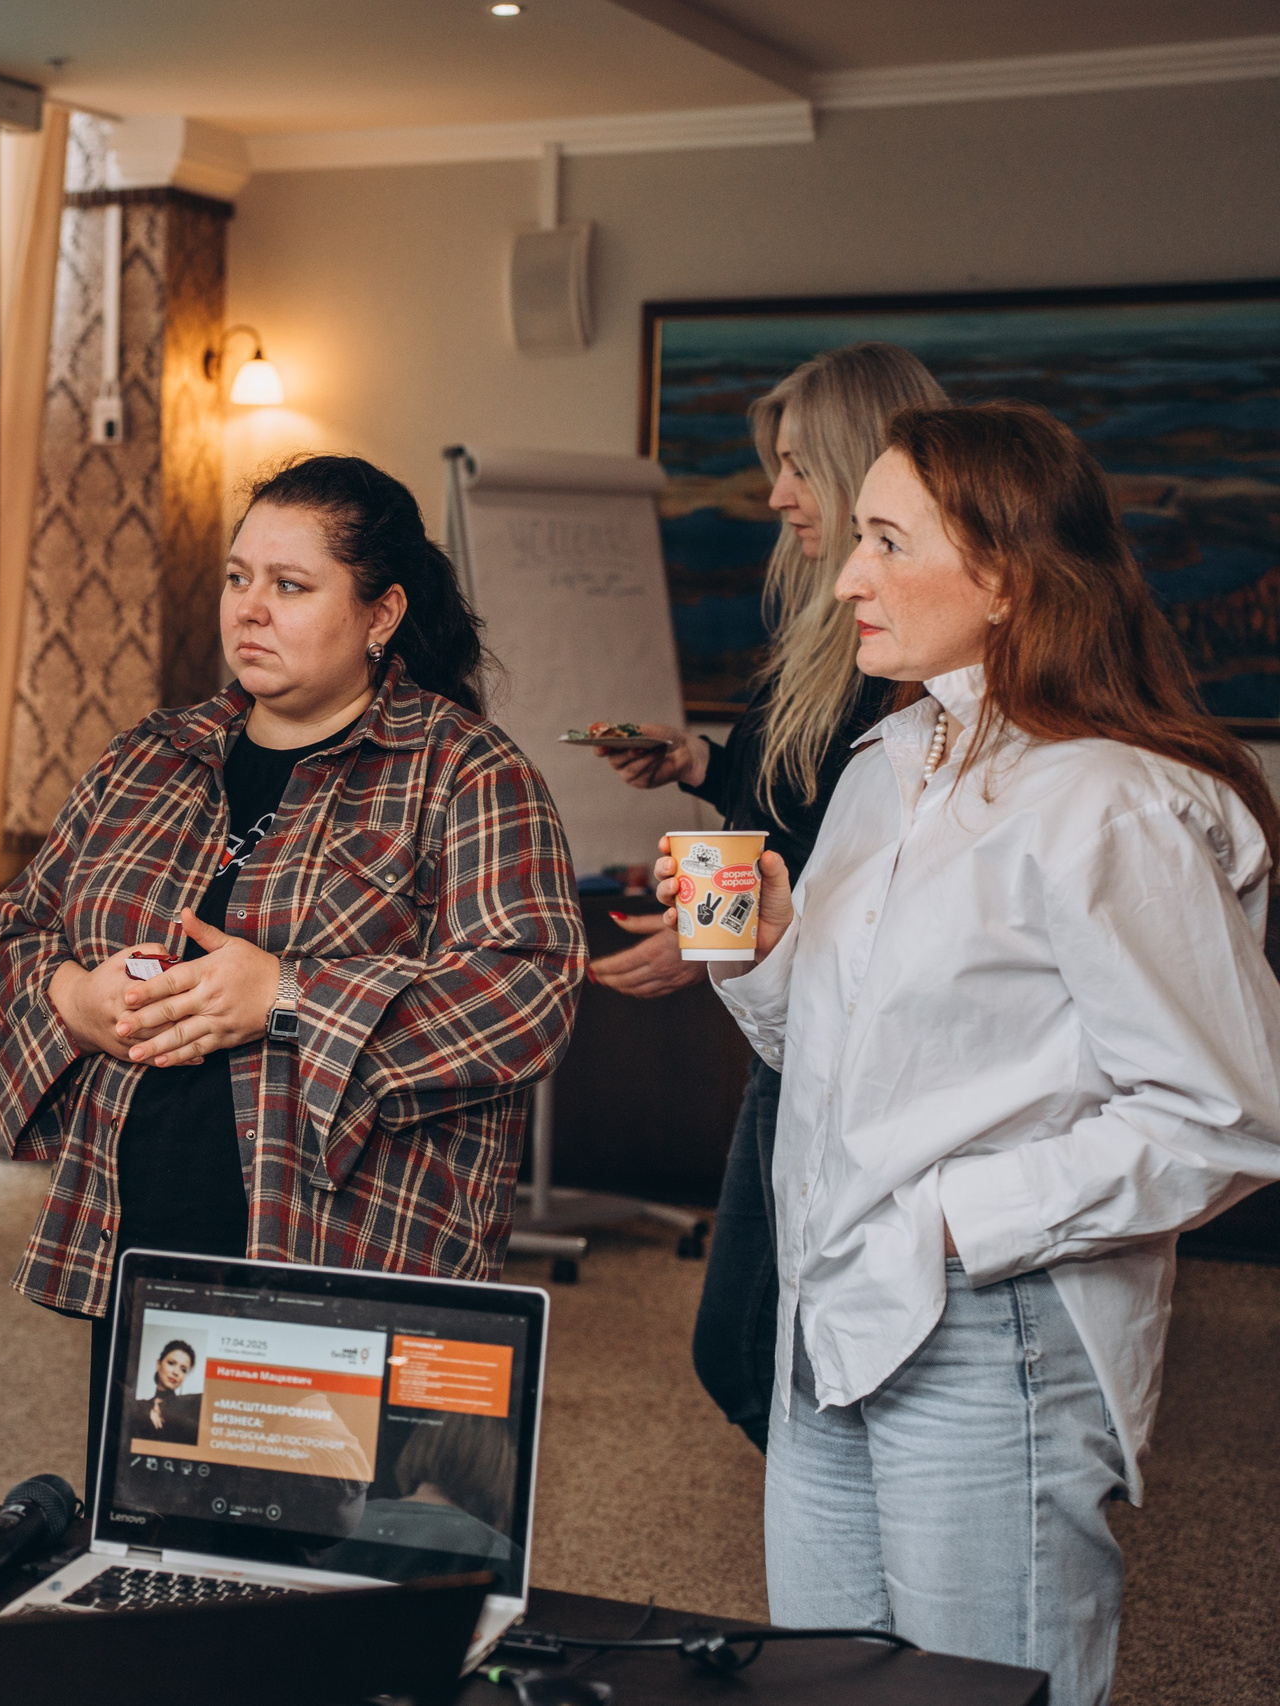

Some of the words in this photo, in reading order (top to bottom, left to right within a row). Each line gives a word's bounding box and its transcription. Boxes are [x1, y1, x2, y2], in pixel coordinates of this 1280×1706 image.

[221, 1337, 268, 1350] 17.04.2025
[217, 1366, 259, 1379] Наталья
[260, 1371, 312, 1386] Мацкевич
[109, 1511, 147, 1525] Lenovo
